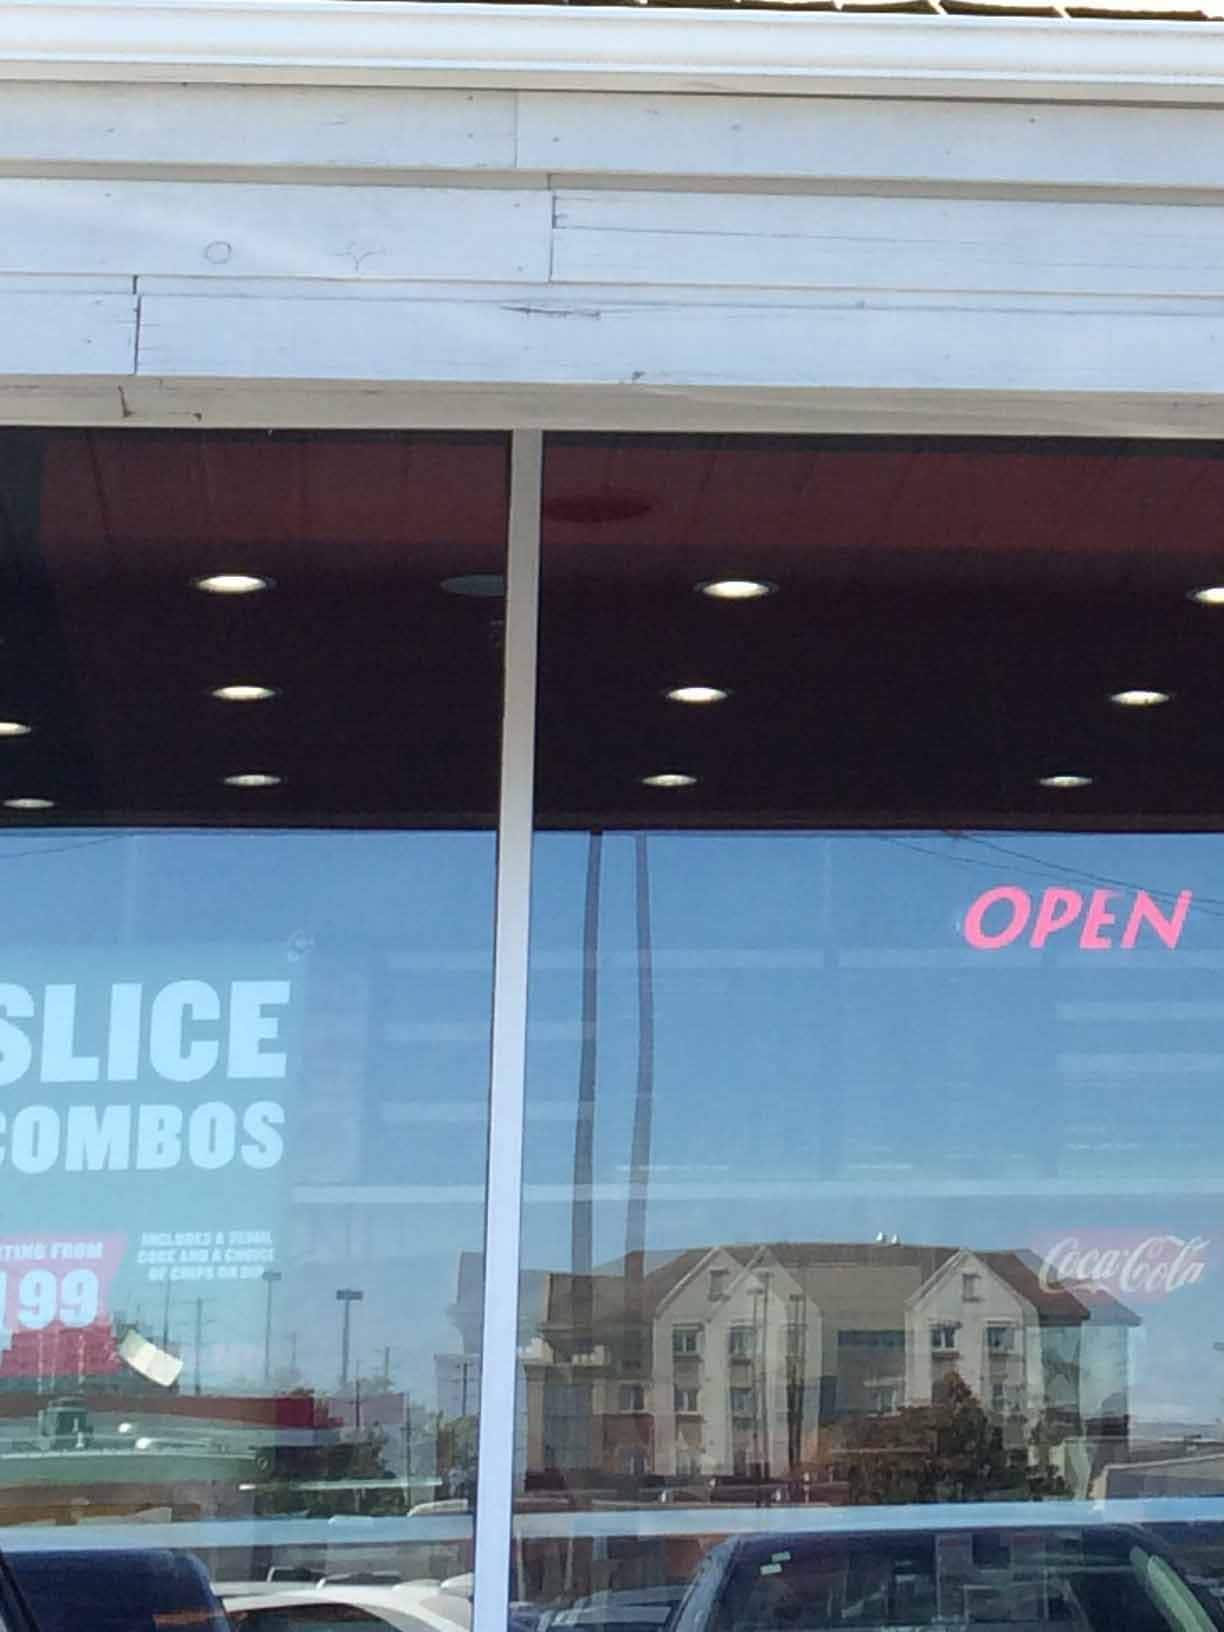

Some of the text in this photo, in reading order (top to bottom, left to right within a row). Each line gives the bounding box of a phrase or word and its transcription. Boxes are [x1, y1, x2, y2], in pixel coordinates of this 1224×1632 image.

[963, 885, 1193, 951] OPEN
[0, 1100, 286, 1174] OMBOS
[1038, 1234, 1211, 1296] Coca-Cola
